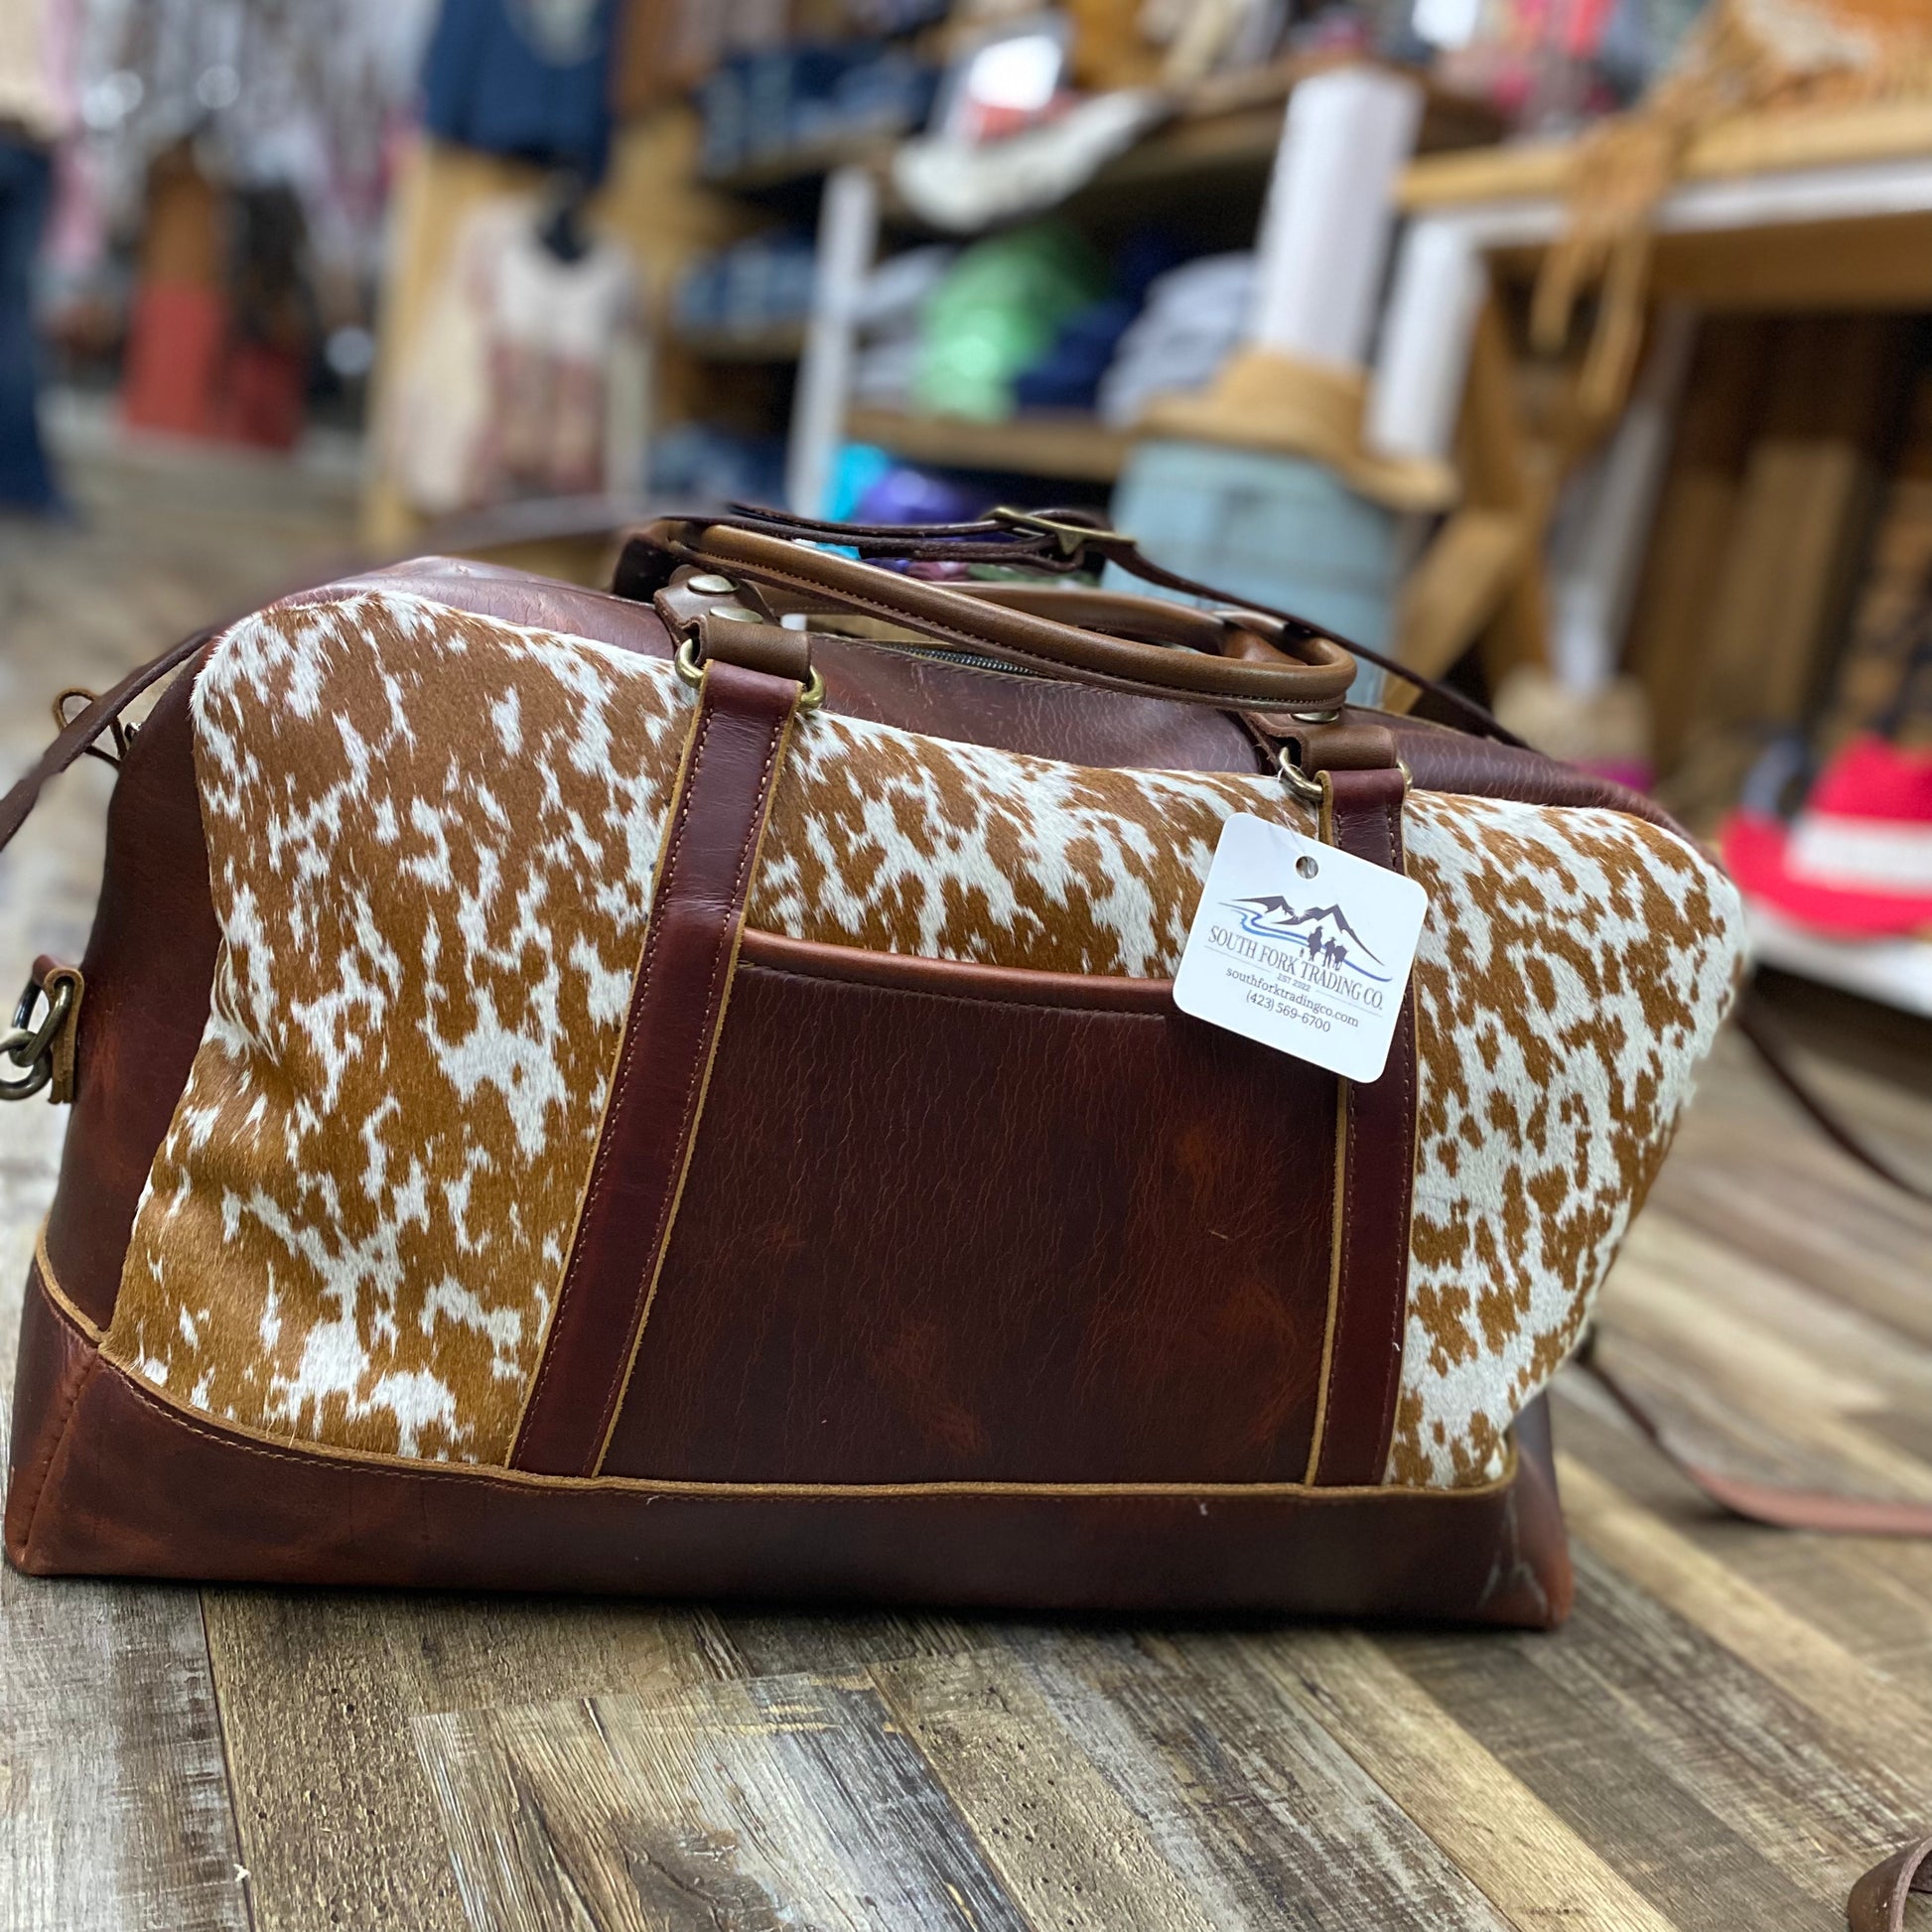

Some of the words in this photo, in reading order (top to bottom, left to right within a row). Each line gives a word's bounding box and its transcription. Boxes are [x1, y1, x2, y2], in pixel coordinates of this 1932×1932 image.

[1208, 925, 1258, 959] SOUTH
[1258, 944, 1299, 975] FORK
[1301, 960, 1362, 1001] TRADING
[1363, 987, 1383, 1011] CO.
[1225, 968, 1359, 1028] southforktradingco.com
[1246, 990, 1275, 1012] (423)
[1276, 1002, 1331, 1033] 569-6700
